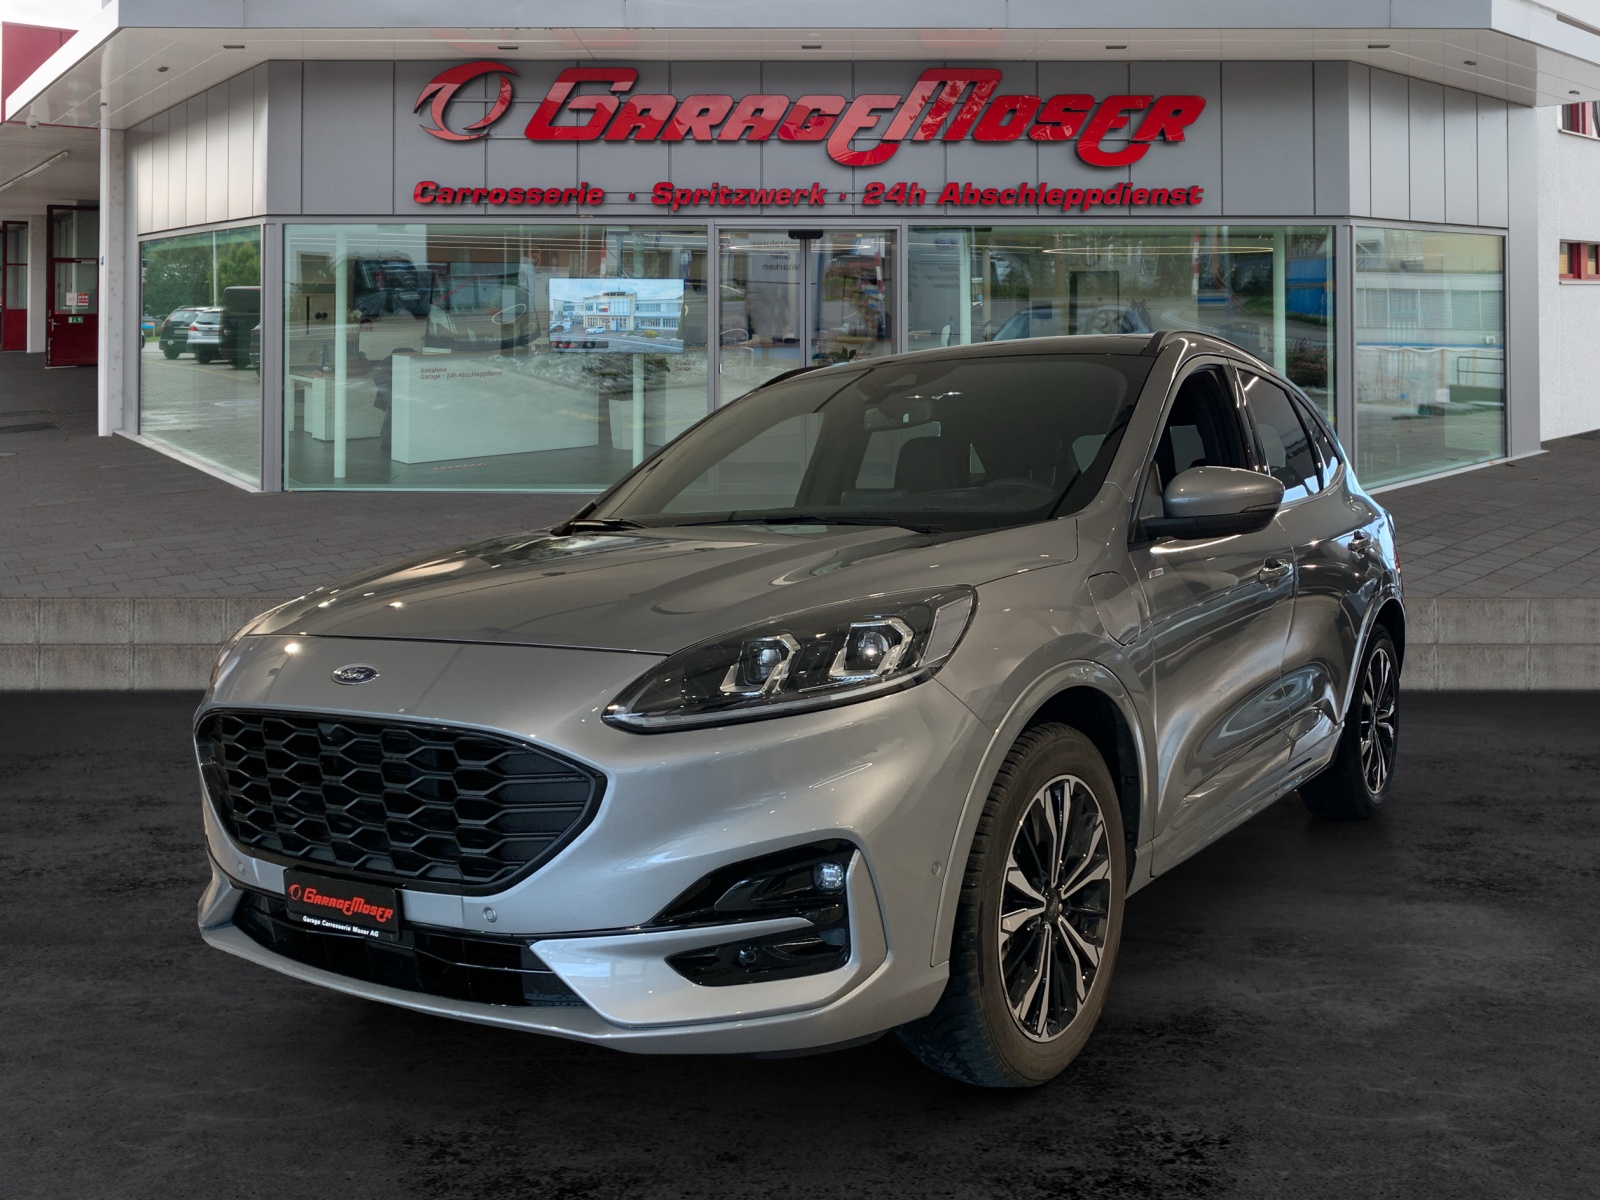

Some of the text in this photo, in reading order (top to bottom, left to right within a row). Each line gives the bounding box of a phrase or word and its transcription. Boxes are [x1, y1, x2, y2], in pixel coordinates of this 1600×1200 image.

[413, 181, 1204, 211] Carrosserie Spritzwerk 24h Abschleppdienst
[302, 916, 320, 925] Garage
[322, 920, 351, 931] Carrosserie
[353, 926, 369, 935] Moser
